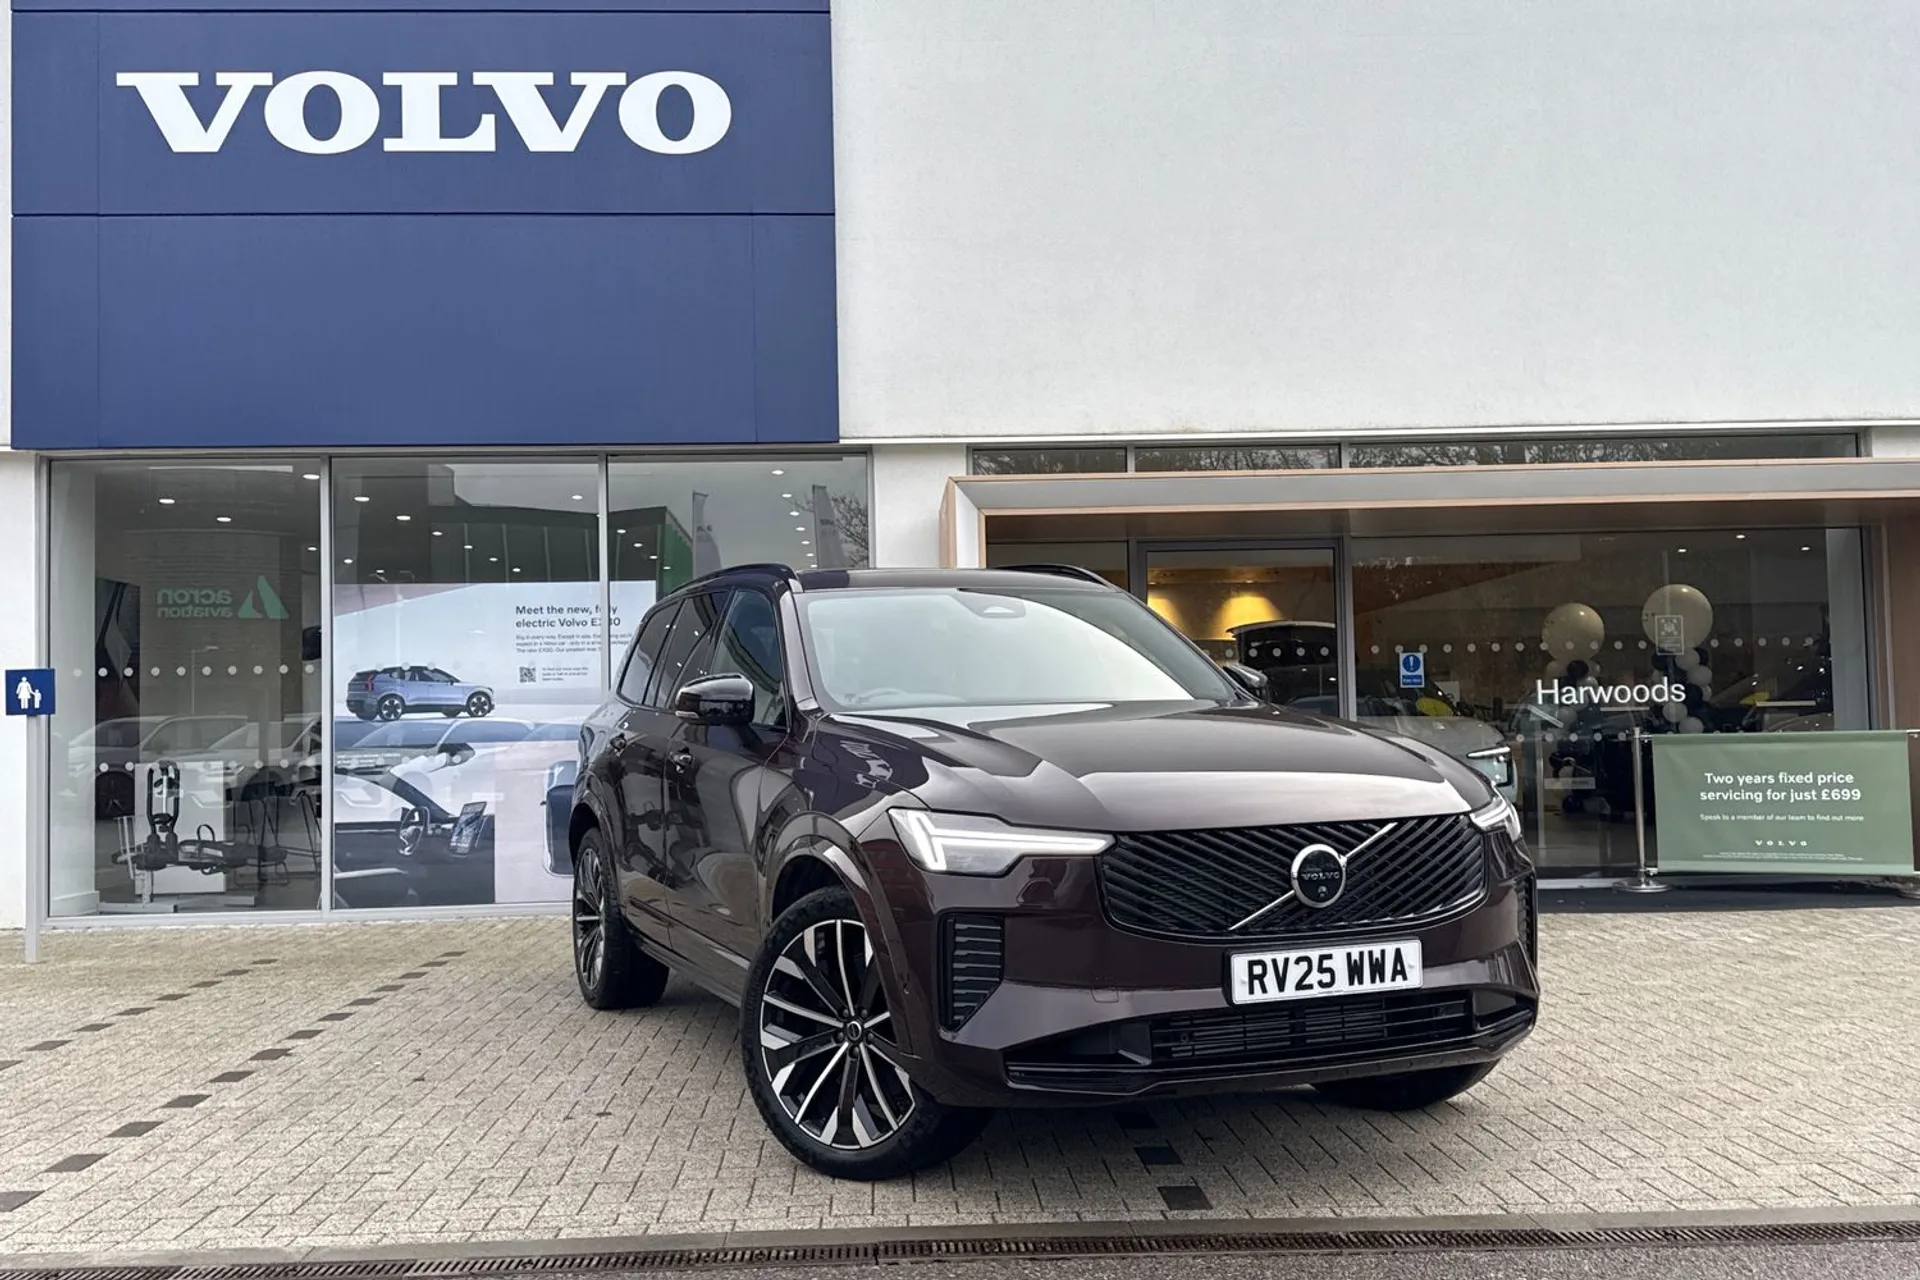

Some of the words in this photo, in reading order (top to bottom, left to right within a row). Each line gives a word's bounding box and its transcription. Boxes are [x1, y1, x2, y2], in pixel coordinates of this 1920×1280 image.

[116, 70, 732, 154] VOLVO
[515, 606, 543, 615] Meet
[546, 605, 564, 615] the
[567, 606, 593, 616] new,
[515, 618, 556, 628] electric
[558, 618, 588, 627] Volvo
[1536, 676, 1686, 705] Harwoods
[1704, 772, 1734, 784] Two
[1736, 775, 1775, 786] years
[1778, 771, 1813, 784] fixed
[1817, 771, 1854, 786] price
[1700, 789, 1763, 803] servicing
[1766, 788, 1787, 800] for
[1789, 788, 1818, 803] just
[1821, 788, 1861, 801] £699
[1700, 813, 1721, 822] Speak
[1301, 871, 1340, 880] VOLVO
[1247, 953, 1336, 995] RV25
[1346, 947, 1408, 987] WWA
